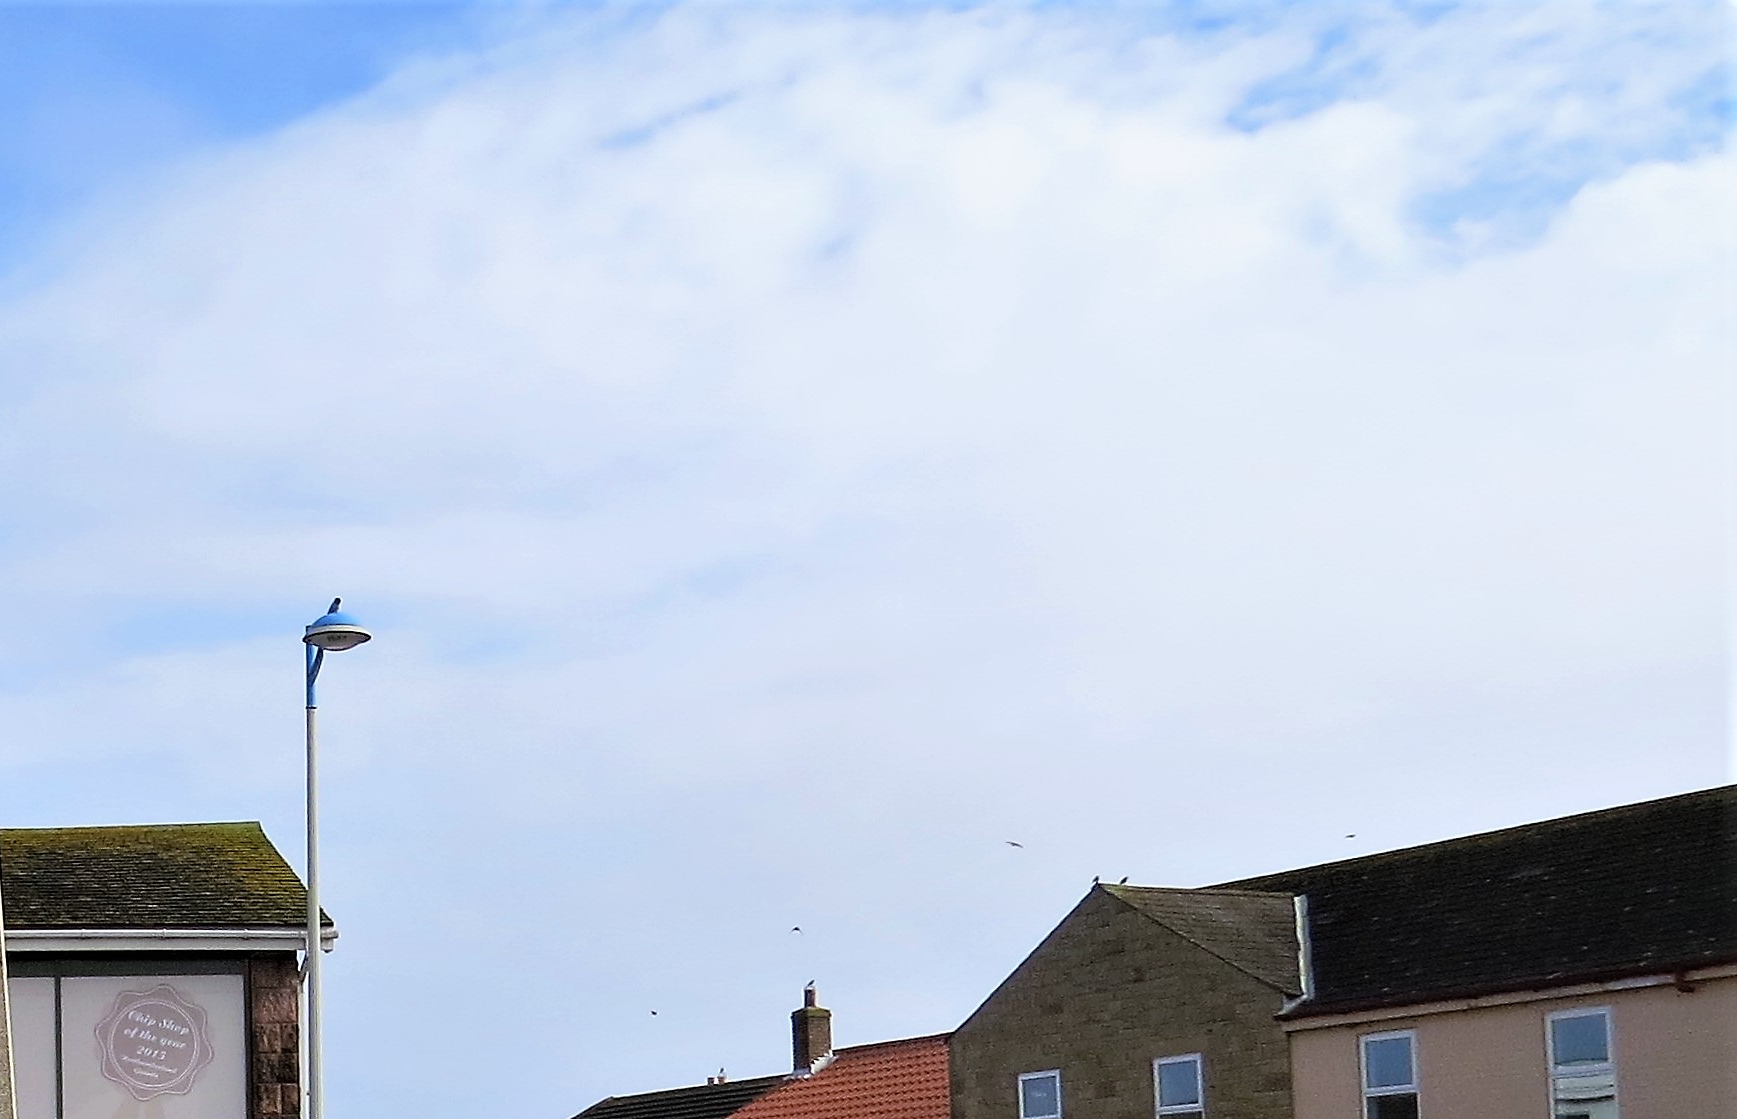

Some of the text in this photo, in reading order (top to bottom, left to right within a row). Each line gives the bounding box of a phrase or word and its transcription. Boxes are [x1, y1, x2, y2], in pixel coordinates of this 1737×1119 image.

[128, 1010, 189, 1035] Chip Shop
[124, 1027, 138, 1038] of
